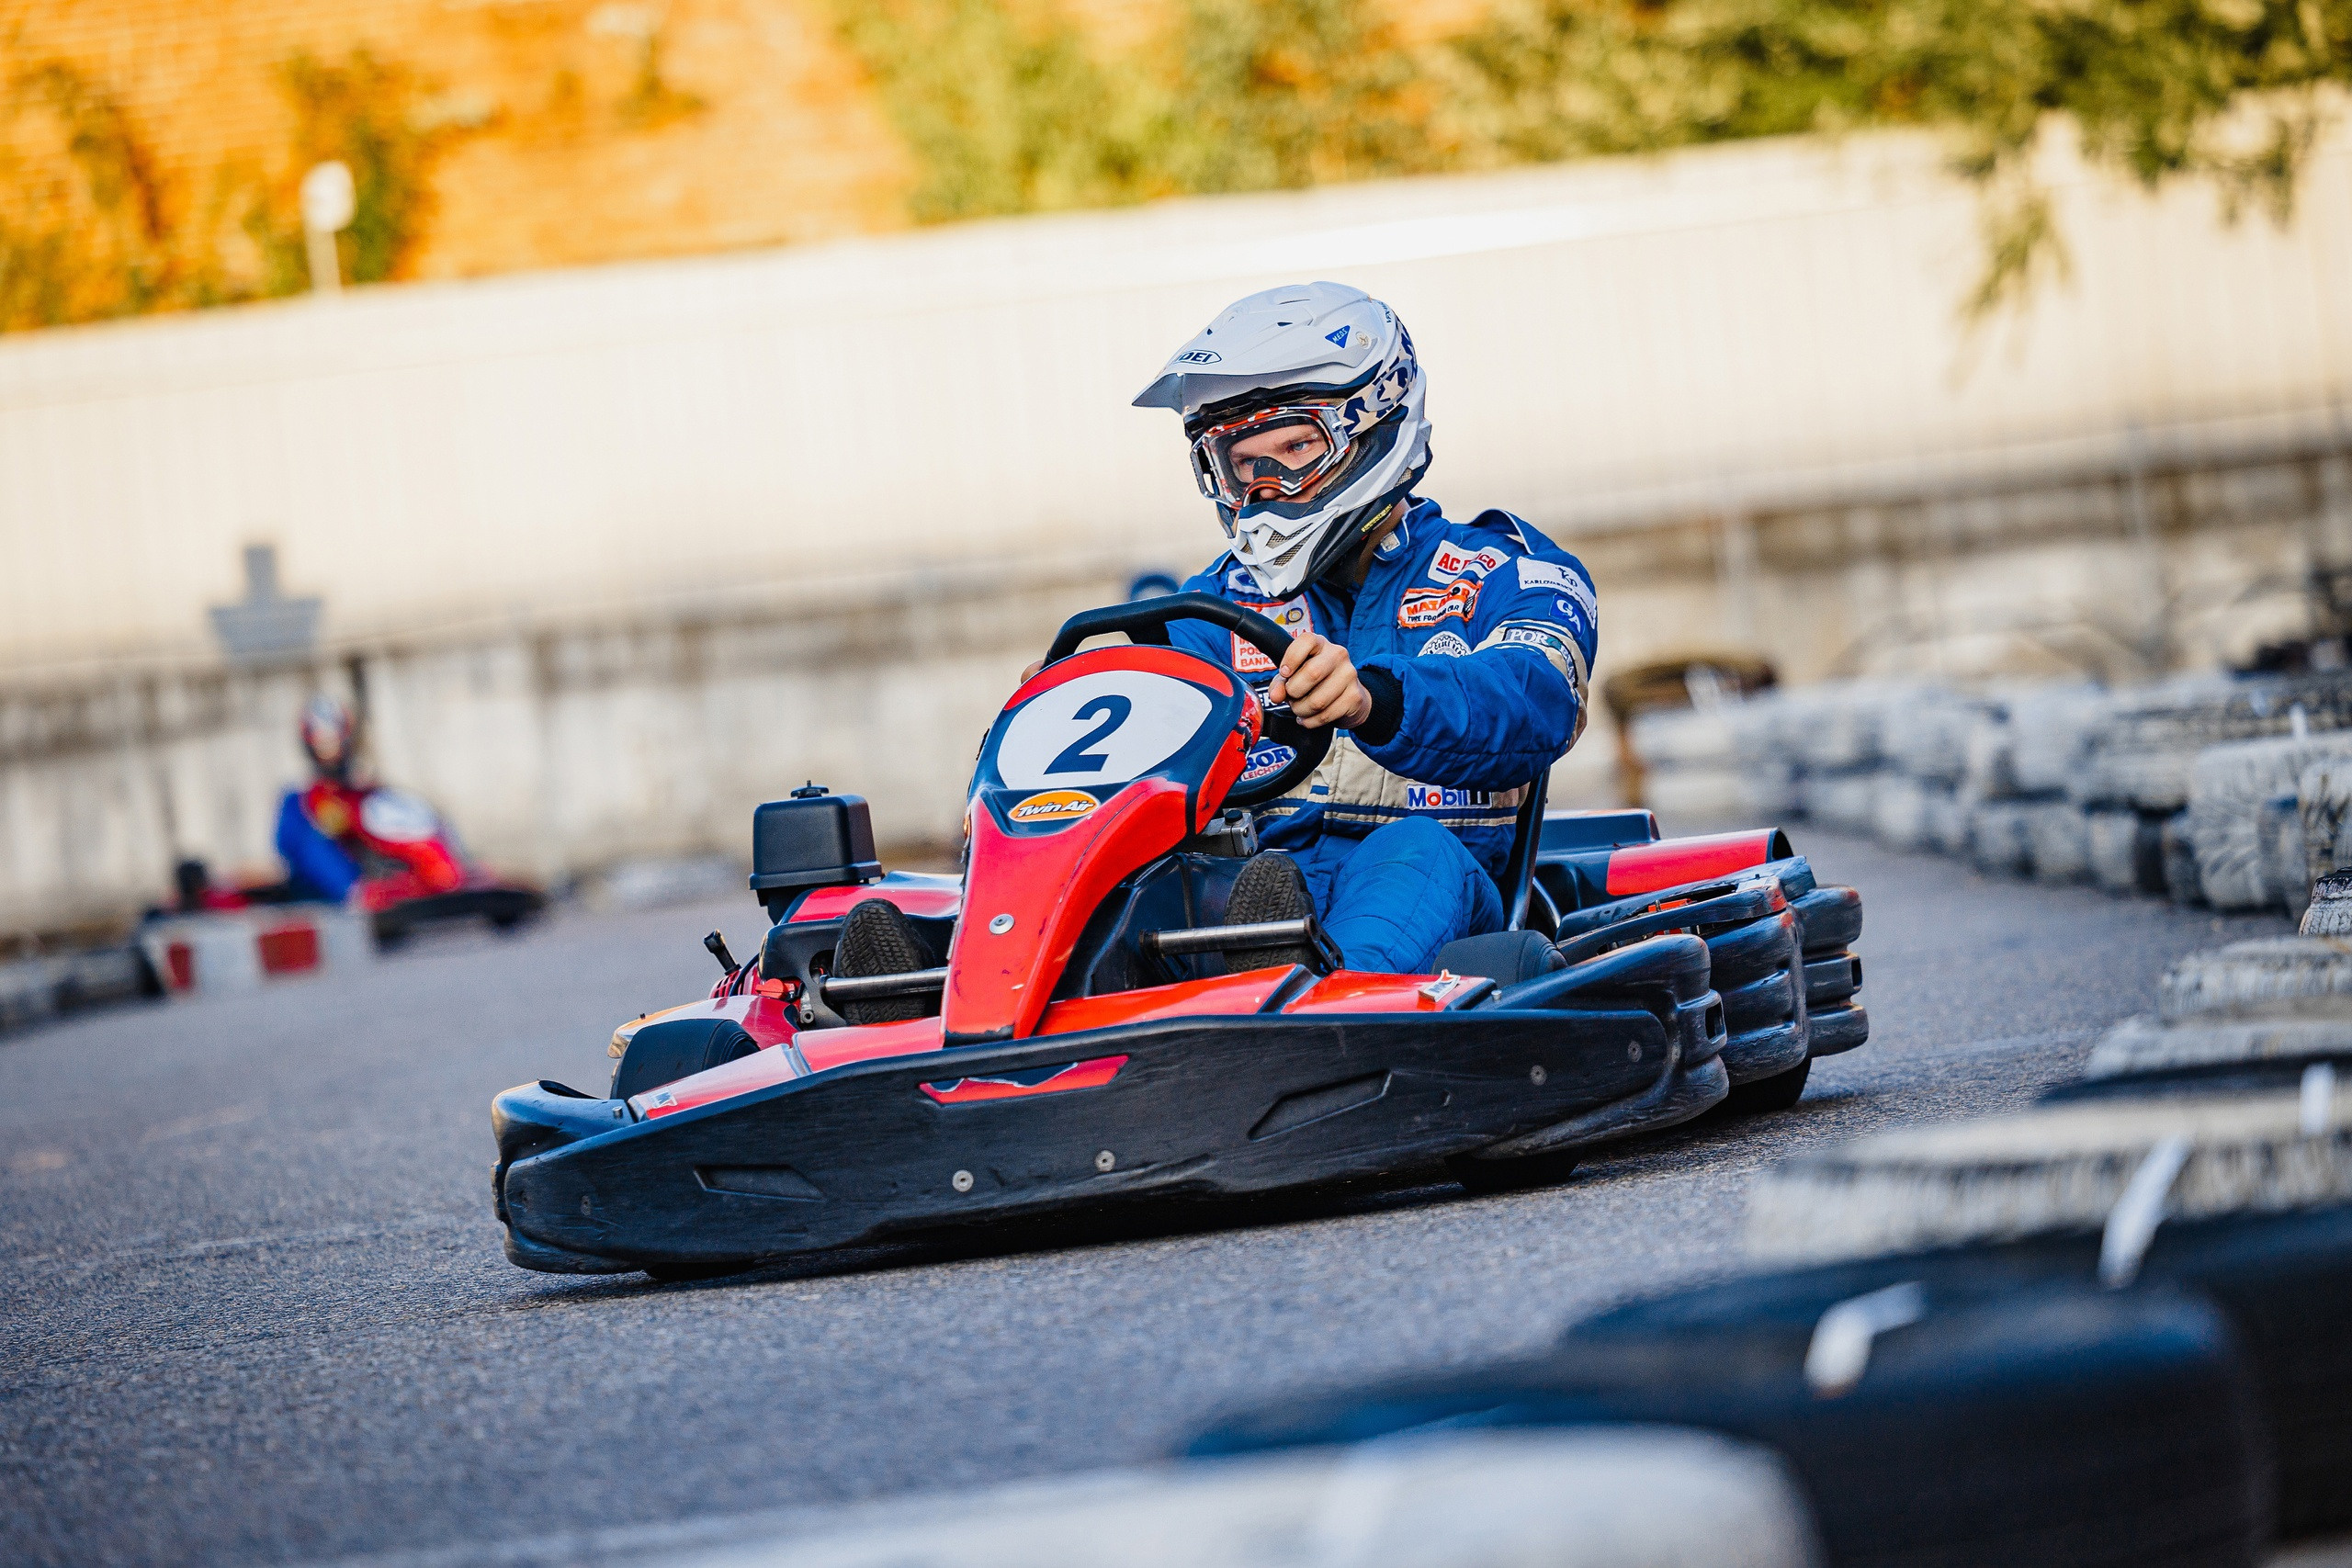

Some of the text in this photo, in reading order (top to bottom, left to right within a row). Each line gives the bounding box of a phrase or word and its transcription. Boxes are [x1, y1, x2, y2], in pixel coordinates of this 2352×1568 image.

[1437, 552, 1461, 571] AC
[1407, 587, 1471, 616] MATAR
[1240, 657, 1273, 667] BANK
[1043, 694, 1132, 775] 2
[1408, 787, 1468, 807] Mobil
[1017, 800, 1095, 818] Twin Air
